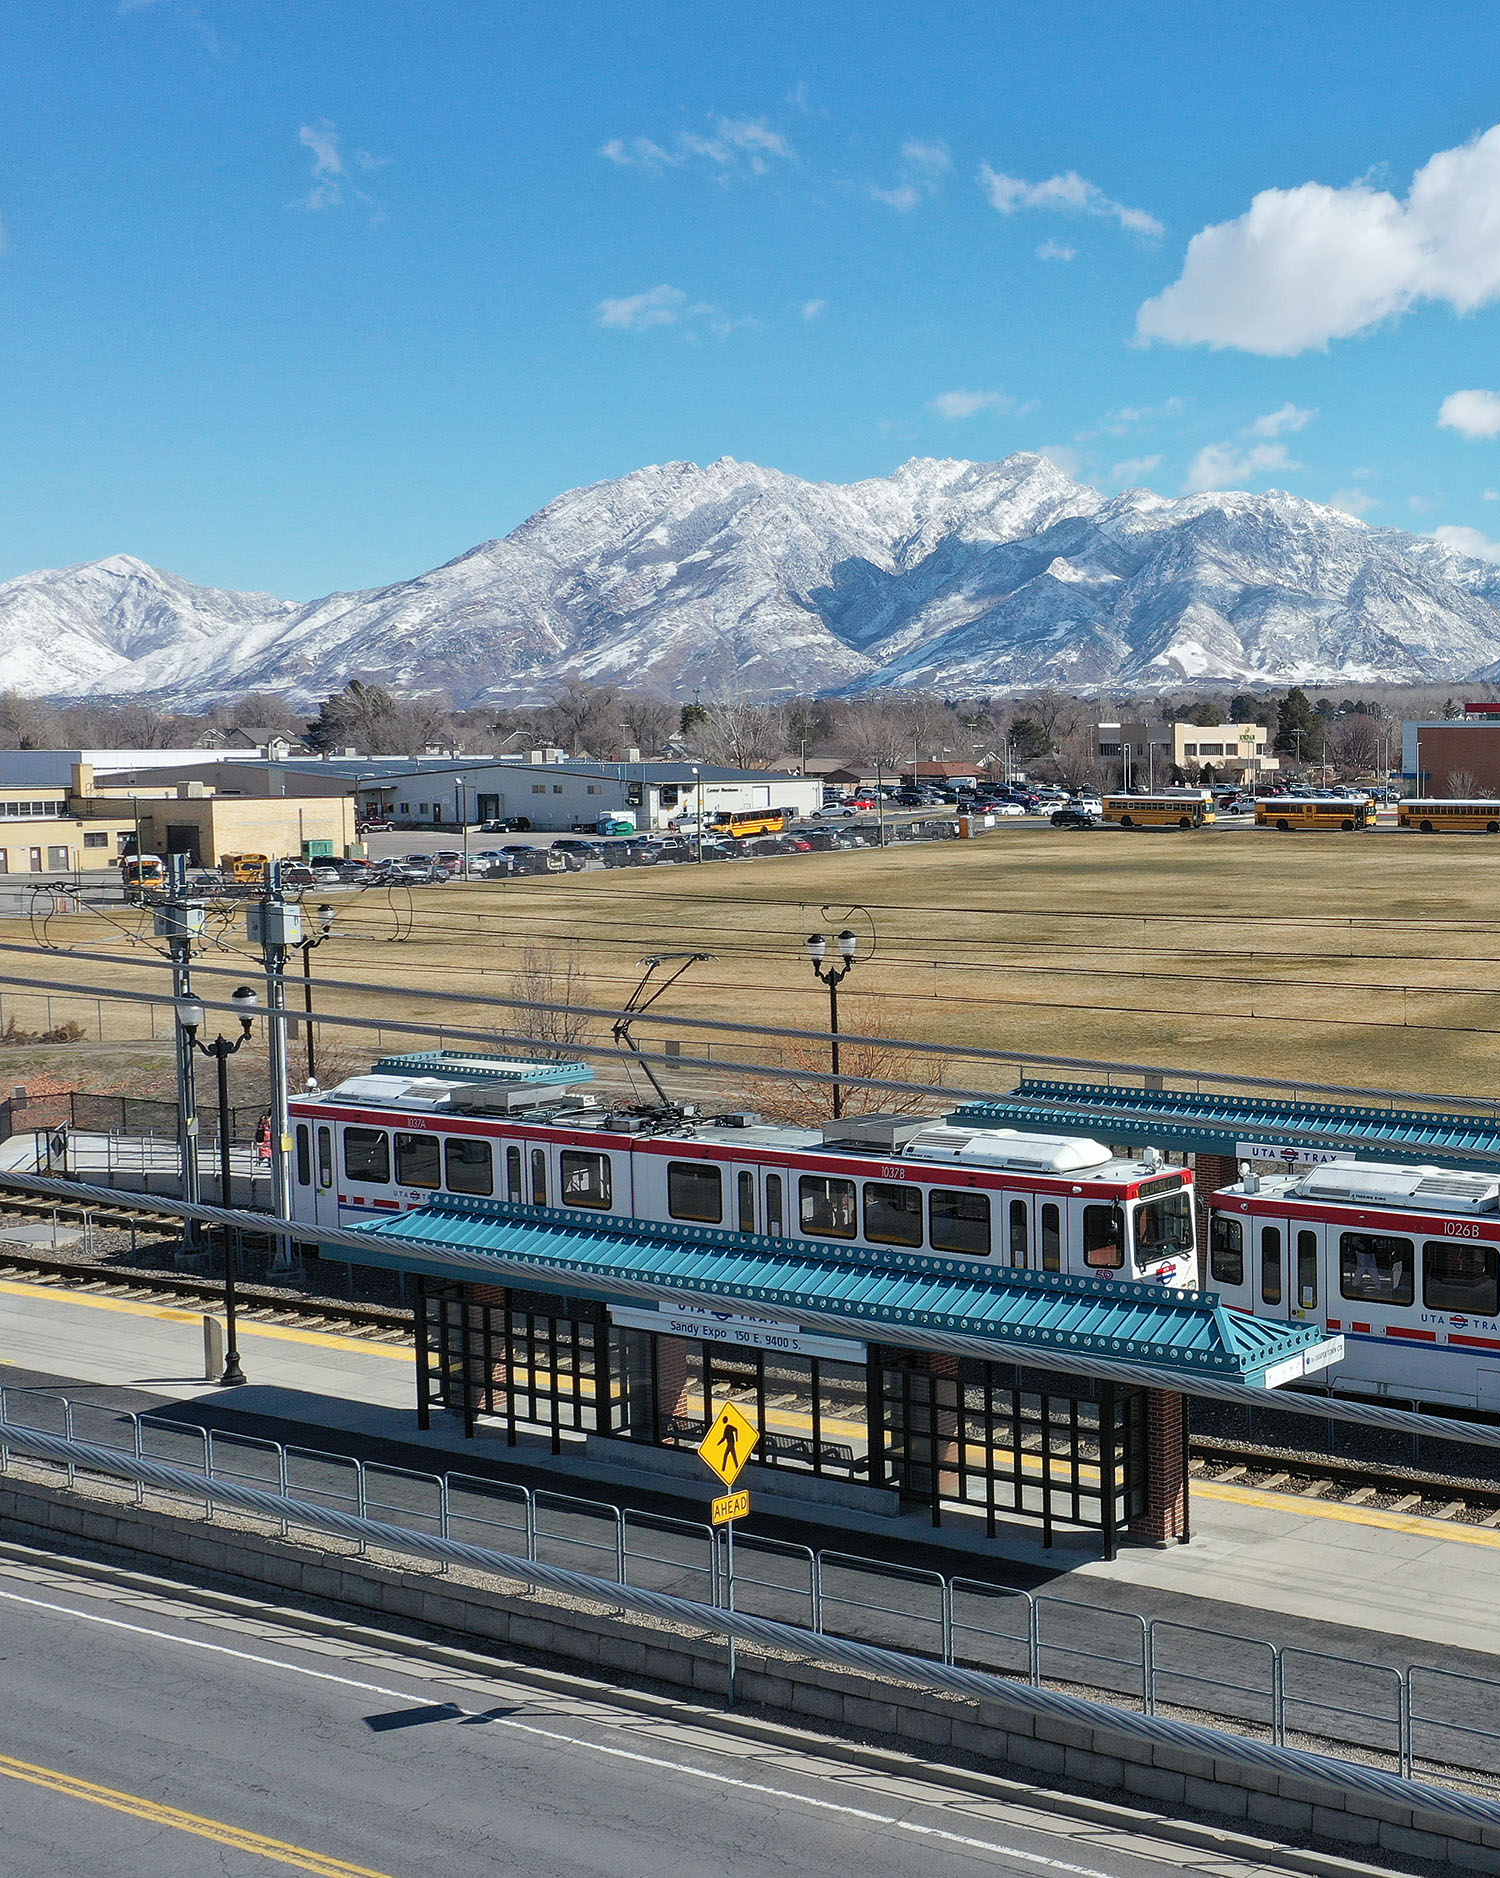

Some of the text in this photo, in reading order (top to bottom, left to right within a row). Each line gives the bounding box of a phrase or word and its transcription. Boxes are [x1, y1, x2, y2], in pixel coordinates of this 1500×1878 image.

[407, 1117, 427, 1129] 1037A
[1252, 1147, 1337, 1163] UTA TRAX
[881, 1166, 906, 1180] 1037B
[393, 1190, 409, 1198] UTA
[1443, 1222, 1480, 1238] 1026B
[1421, 1314, 1445, 1325] UTA
[670, 1320, 801, 1350] Sandy Expo 150 E. 9400 S.
[714, 1496, 747, 1518] AHEAD
